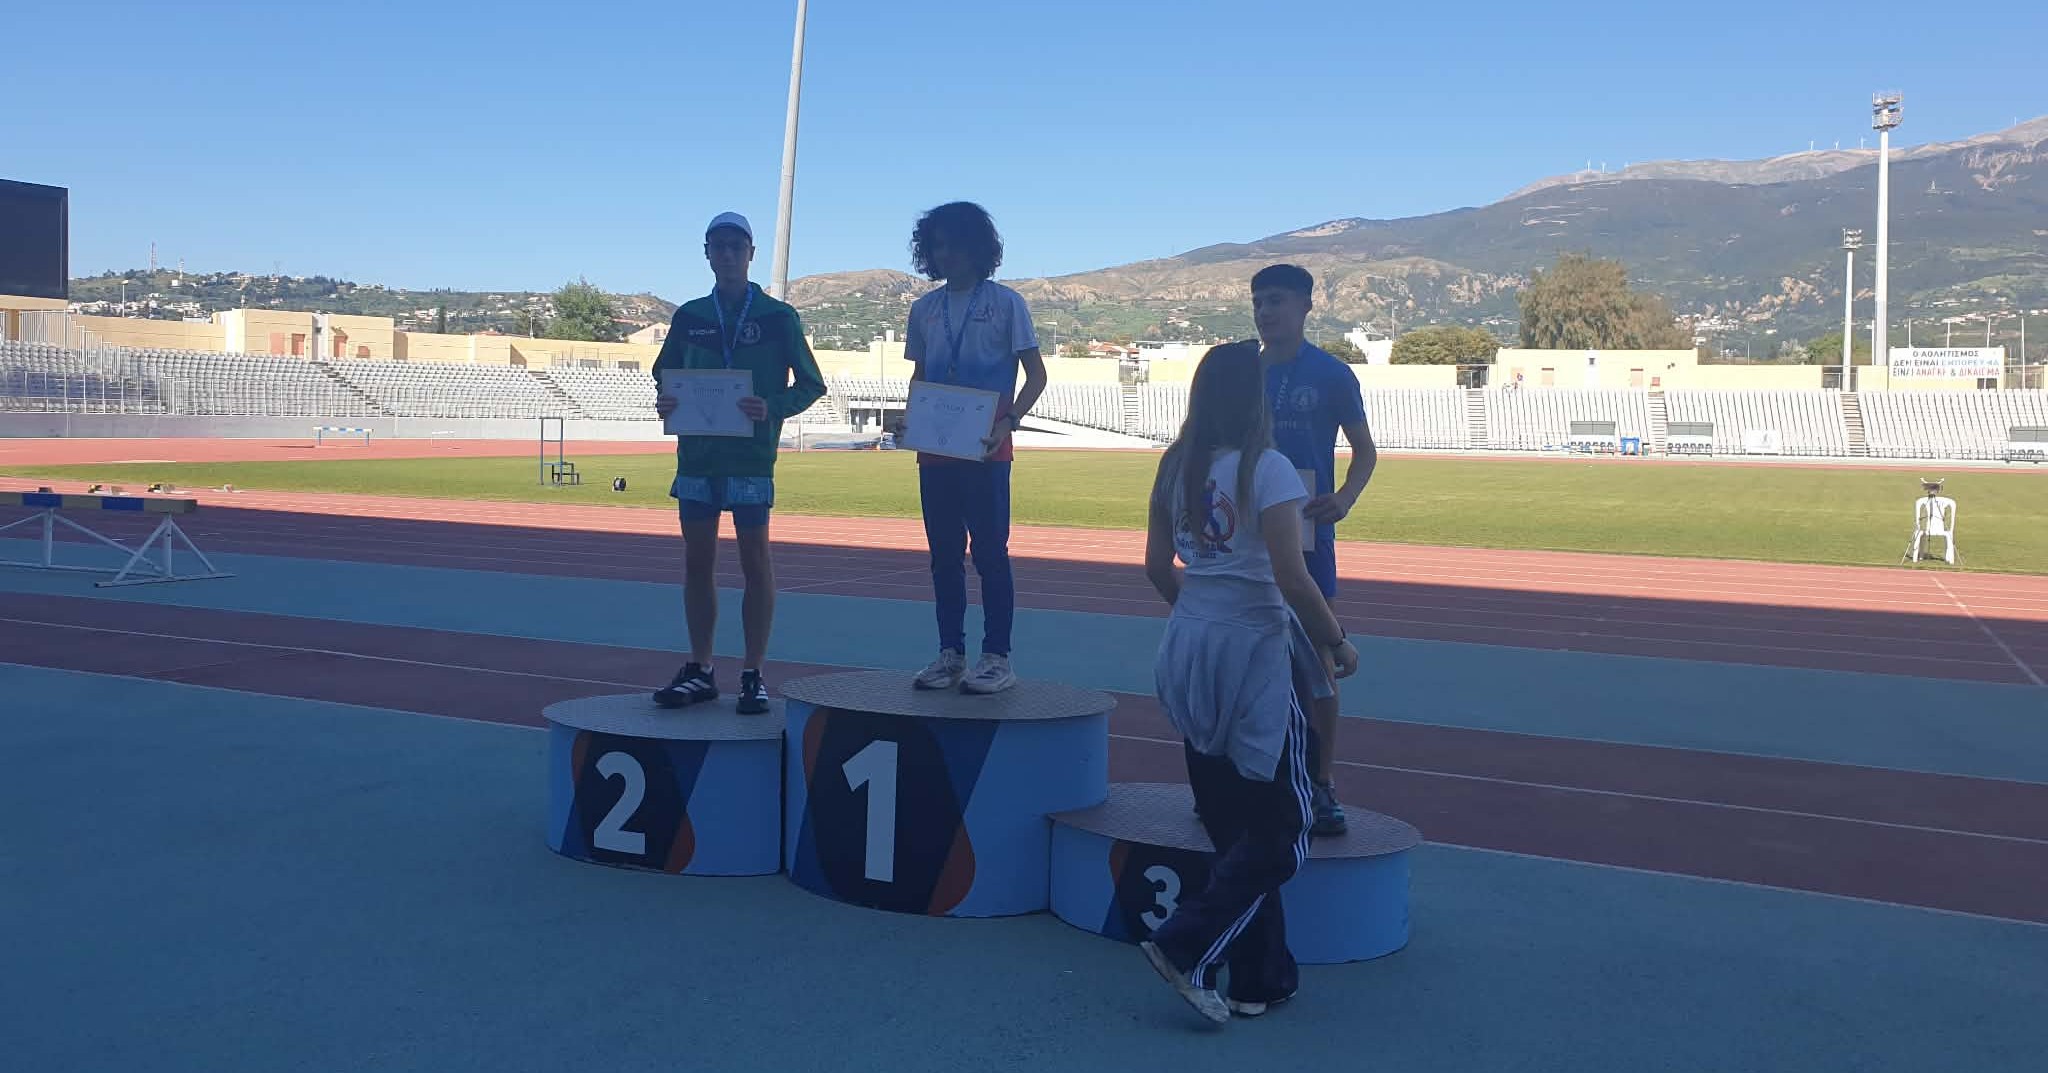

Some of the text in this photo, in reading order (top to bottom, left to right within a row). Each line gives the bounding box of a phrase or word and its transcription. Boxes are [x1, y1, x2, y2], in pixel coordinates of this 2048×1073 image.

[1893, 359, 1913, 367] ΔΕΝ
[1914, 359, 1939, 367] ΕΙΝΑΙ
[1921, 350, 1980, 358] ΑΘΛΗΤΙΣΜΟΣ
[1950, 367, 1957, 377] &
[594, 751, 646, 855] 2
[842, 740, 898, 883] 1
[1140, 865, 1181, 932] 3
